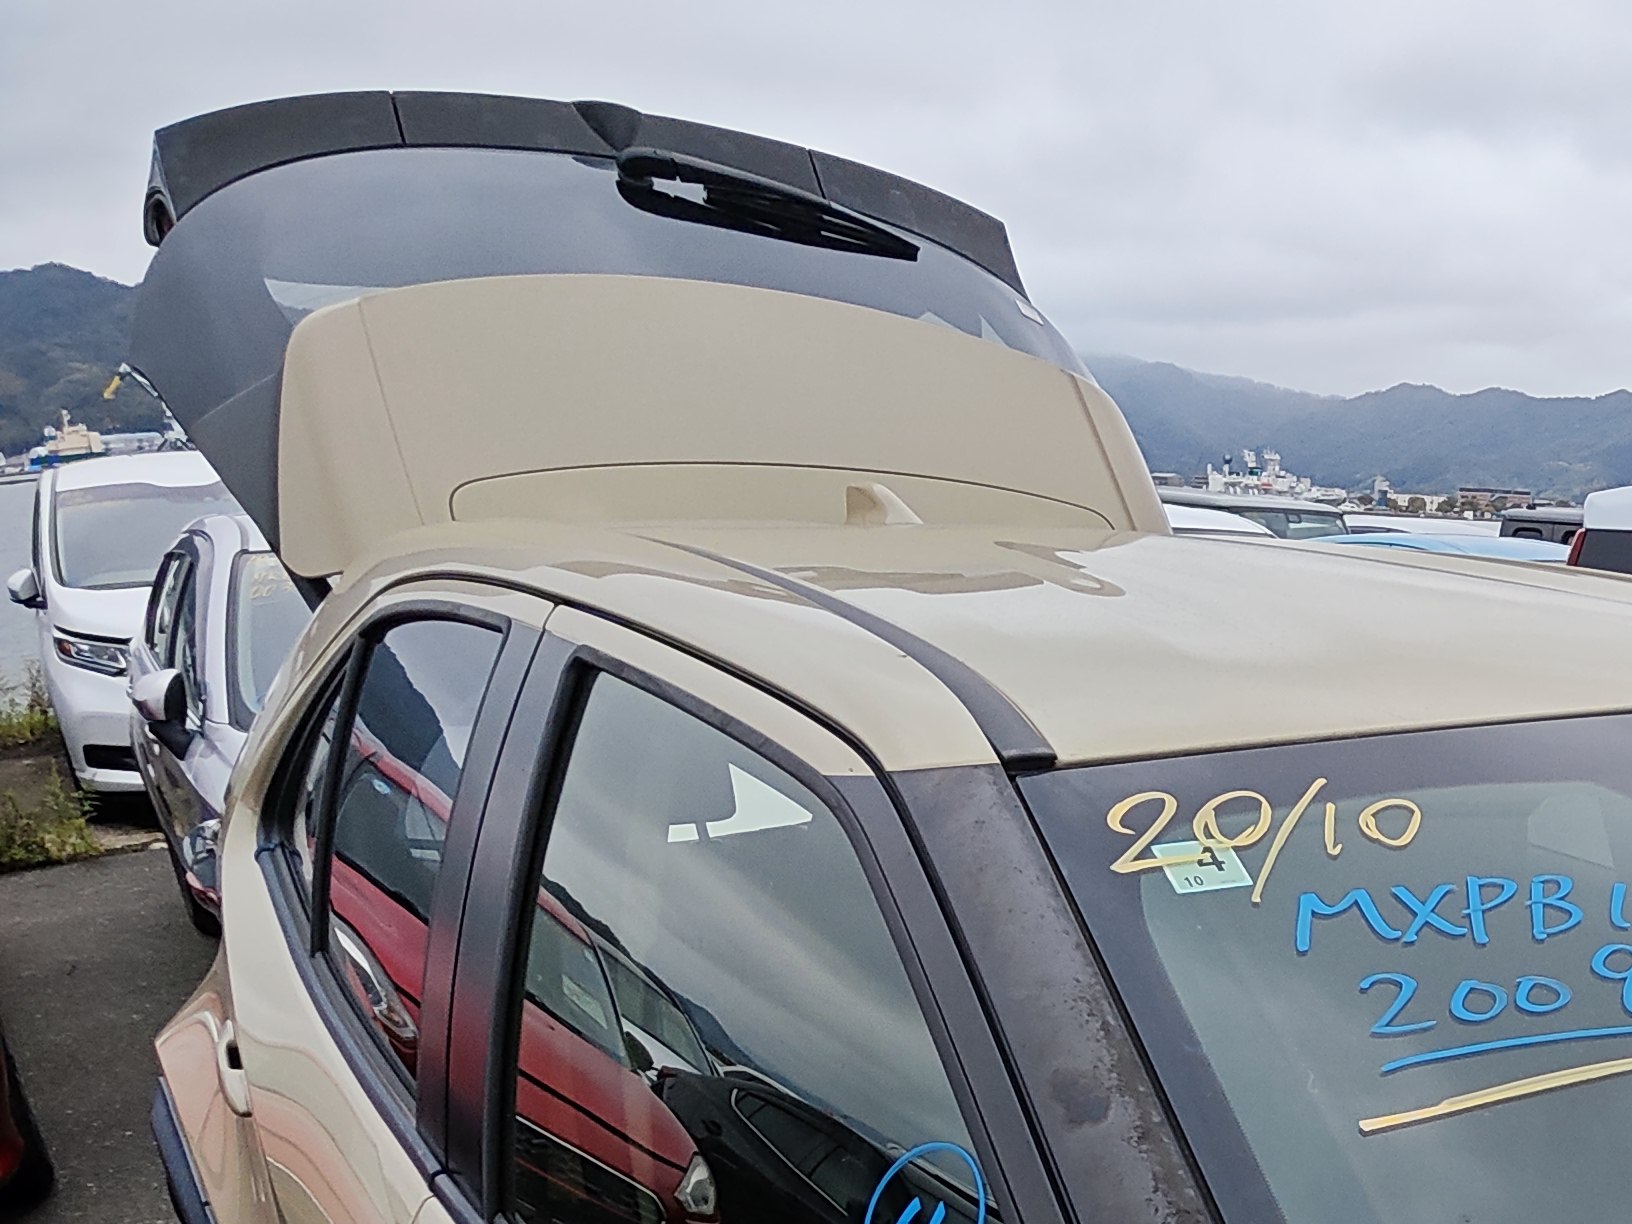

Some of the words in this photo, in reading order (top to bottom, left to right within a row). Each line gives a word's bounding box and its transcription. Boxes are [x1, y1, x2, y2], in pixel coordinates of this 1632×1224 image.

[1106, 777, 1422, 903] 20/10
[1197, 846, 1226, 872] 4
[1184, 875, 1204, 888] 10
